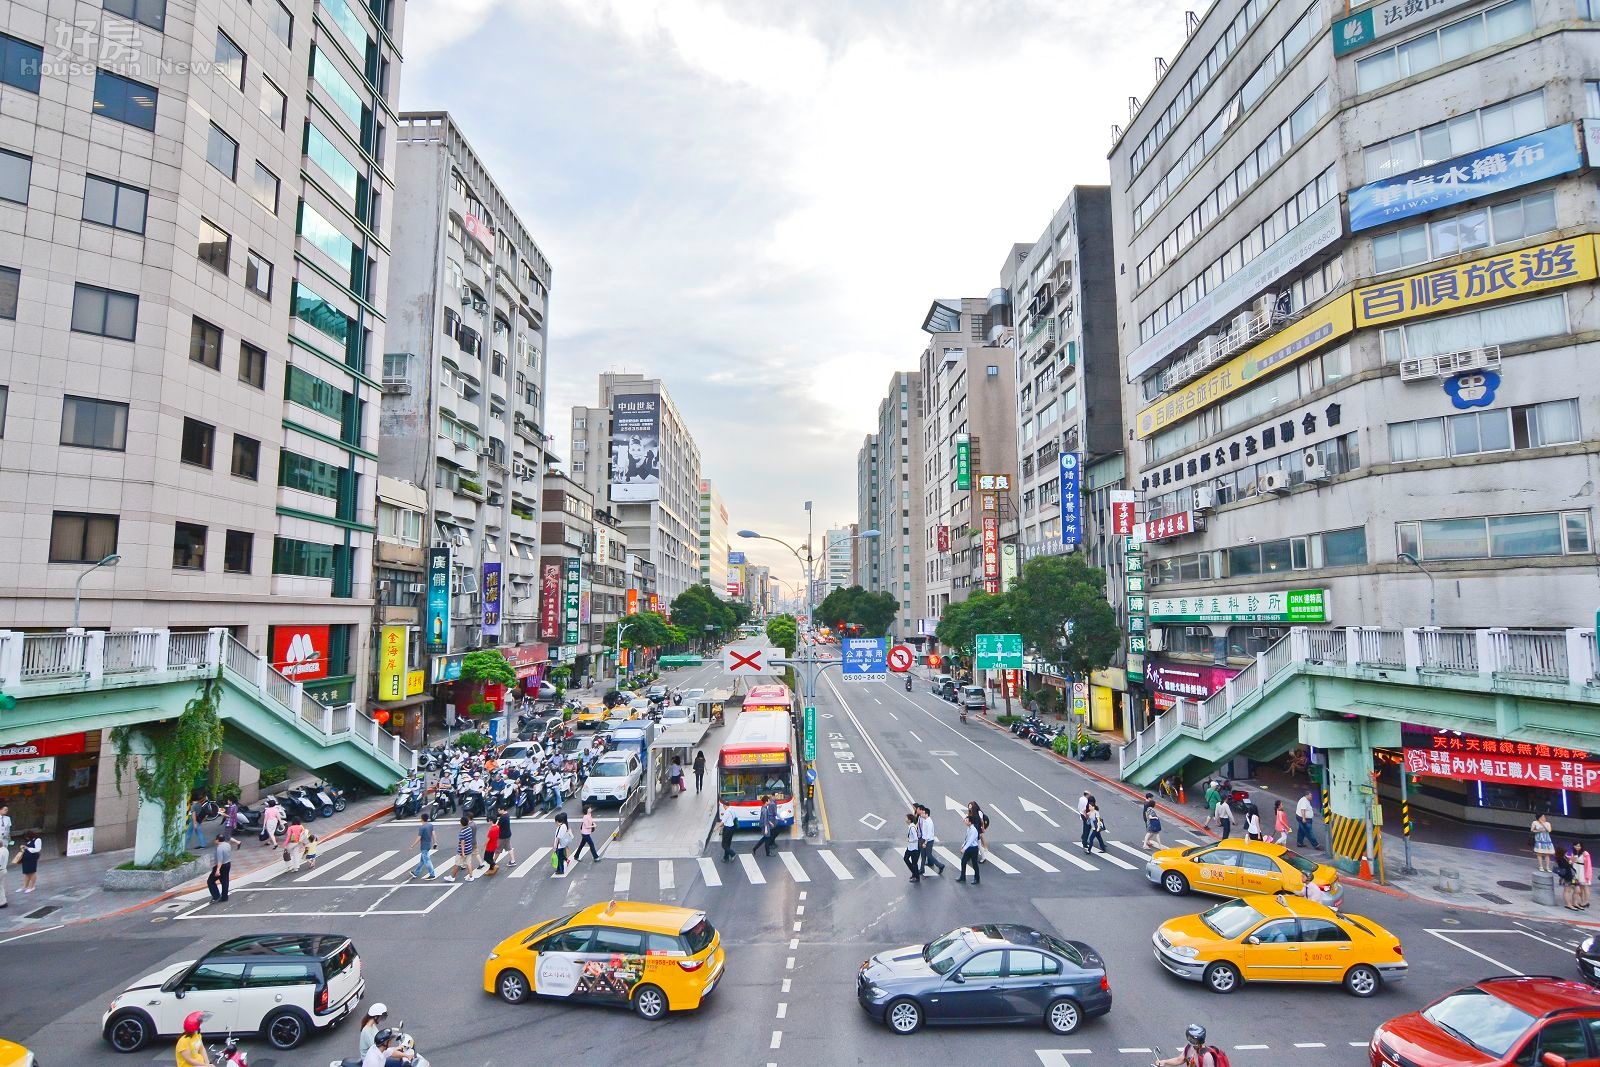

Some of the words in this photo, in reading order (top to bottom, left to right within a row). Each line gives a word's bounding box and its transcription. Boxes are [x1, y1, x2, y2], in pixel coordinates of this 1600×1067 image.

[1371, 142, 1545, 207] 華信水織布
[1384, 195, 1439, 216] TAIWAN
[1359, 243, 1579, 320] 百順旅遊
[1155, 369, 1235, 426] 百順綜合旅行社
[618, 401, 655, 411] 中山世紀
[979, 475, 1009, 490] 優良
[983, 495, 995, 510] 當
[1066, 536, 1076, 544] 5F
[567, 570, 579, 631] 住商不動產
[386, 632, 399, 671] 金海岸
[845, 649, 883, 658] 公車專用
[1146, 663, 1164, 691] 天外天
[1407, 749, 1429, 773] 徵
[1430, 750, 1450, 763] 早班
[1431, 763, 1452, 776] 晚班
[1560, 761, 1583, 775] 平日
[1561, 774, 1585, 789] 假日
